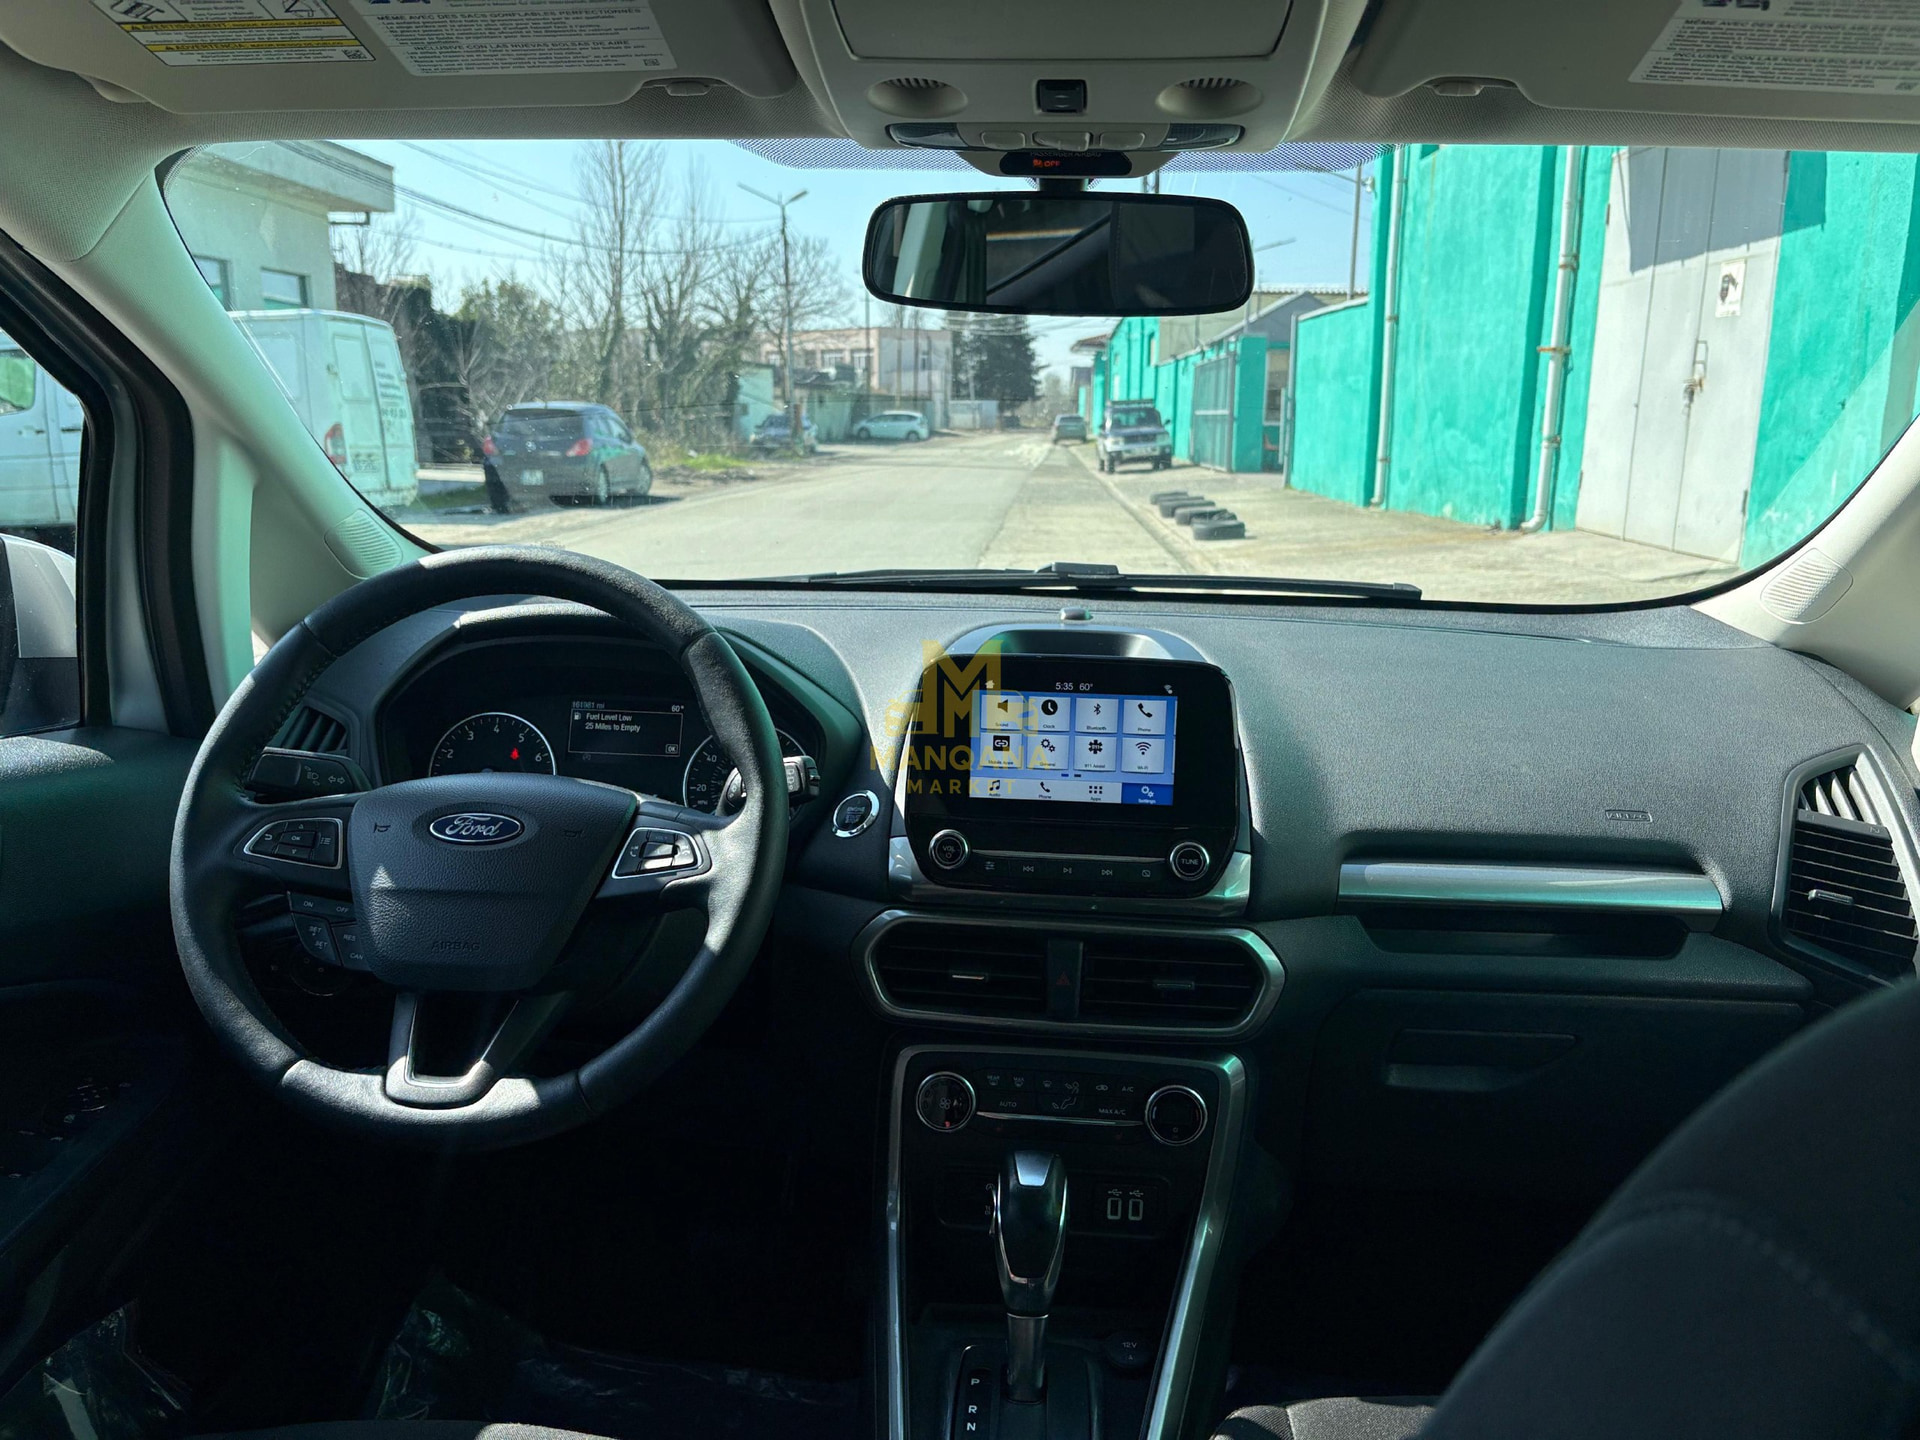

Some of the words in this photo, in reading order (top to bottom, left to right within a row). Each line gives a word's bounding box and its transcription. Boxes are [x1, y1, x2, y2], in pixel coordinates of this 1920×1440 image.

[1055, 683, 1074, 691] 5:35
[586, 712, 600, 721] Fuel
[601, 713, 618, 721] Level
[619, 714, 633, 722] Low
[493, 725, 500, 734] 4
[585, 722, 594, 730] 25
[595, 722, 612, 731] Miles
[613, 723, 620, 731] to
[620, 724, 641, 733] Empty
[467, 730, 474, 741] 3
[518, 733, 525, 743] 5
[446, 749, 454, 759] 2
[535, 754, 542, 762] 6
[706, 754, 717, 763] 40
[696, 784, 707, 792] 20
[445, 815, 504, 836] Ford
[303, 900, 314, 908] ON
[336, 906, 350, 914] OFF
[431, 940, 480, 952] AIRBAG
[349, 952, 364, 960] CAN
[1121, 1085, 1134, 1093] A/C
[1121, 1341, 1138, 1349] 12V
[970, 1378, 981, 1386] P
[968, 1404, 978, 1414] R
[966, 1422, 977, 1431] N
